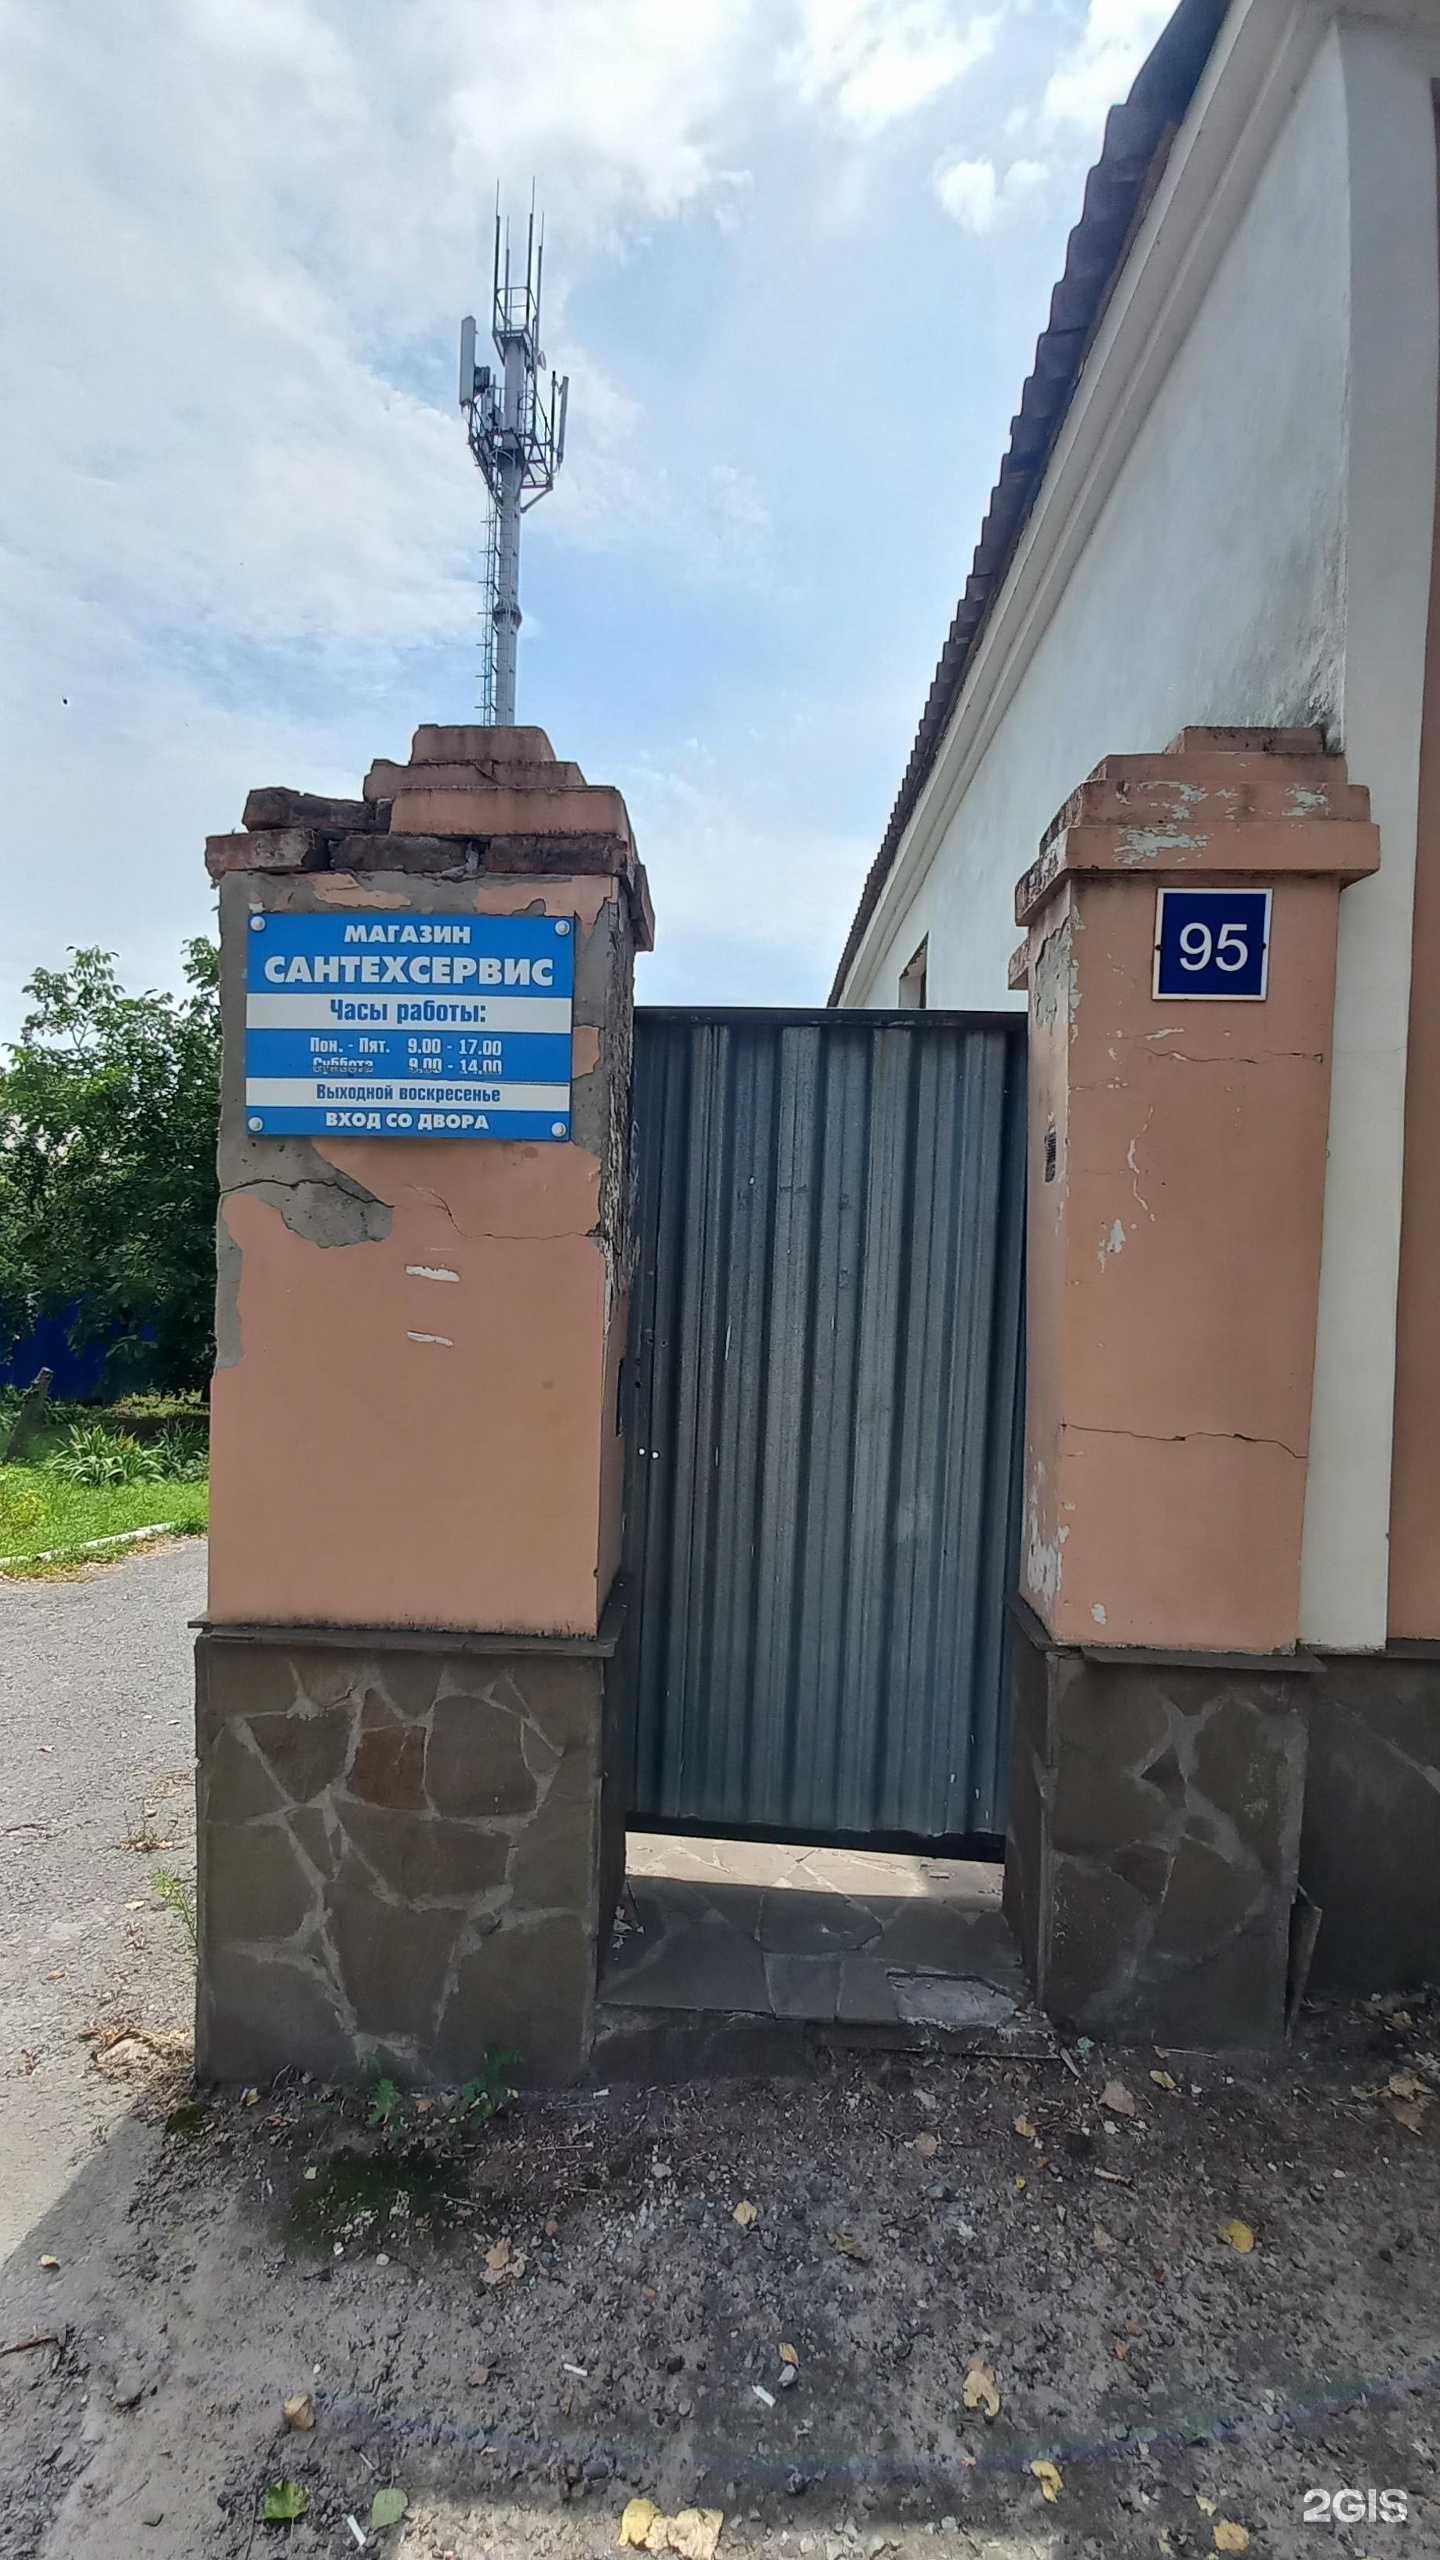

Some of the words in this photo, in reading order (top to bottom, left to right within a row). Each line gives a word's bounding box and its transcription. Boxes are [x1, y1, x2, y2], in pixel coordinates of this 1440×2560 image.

[344, 925, 471, 944] МАГАЗИН
[1180, 922, 1248, 971] 95
[264, 956, 553, 986] САНТЕХСЕРВИС
[330, 999, 388, 1021] Часы
[396, 1003, 486, 1024] работы:
[310, 1037, 343, 1053] Пон.
[359, 1038, 390, 1054] Пят.
[408, 1038, 441, 1054] 9.00
[459, 1040, 502, 1055] 17.00
[408, 1058, 442, 1074] 9.00
[459, 1059, 502, 1075] 14.00
[316, 1084, 393, 1101] Выходной
[400, 1087, 500, 1103] воскресенье
[325, 1112, 381, 1129] ВХОД
[386, 1113, 412, 1128] СО
[418, 1114, 489, 1130] ДВОРА
